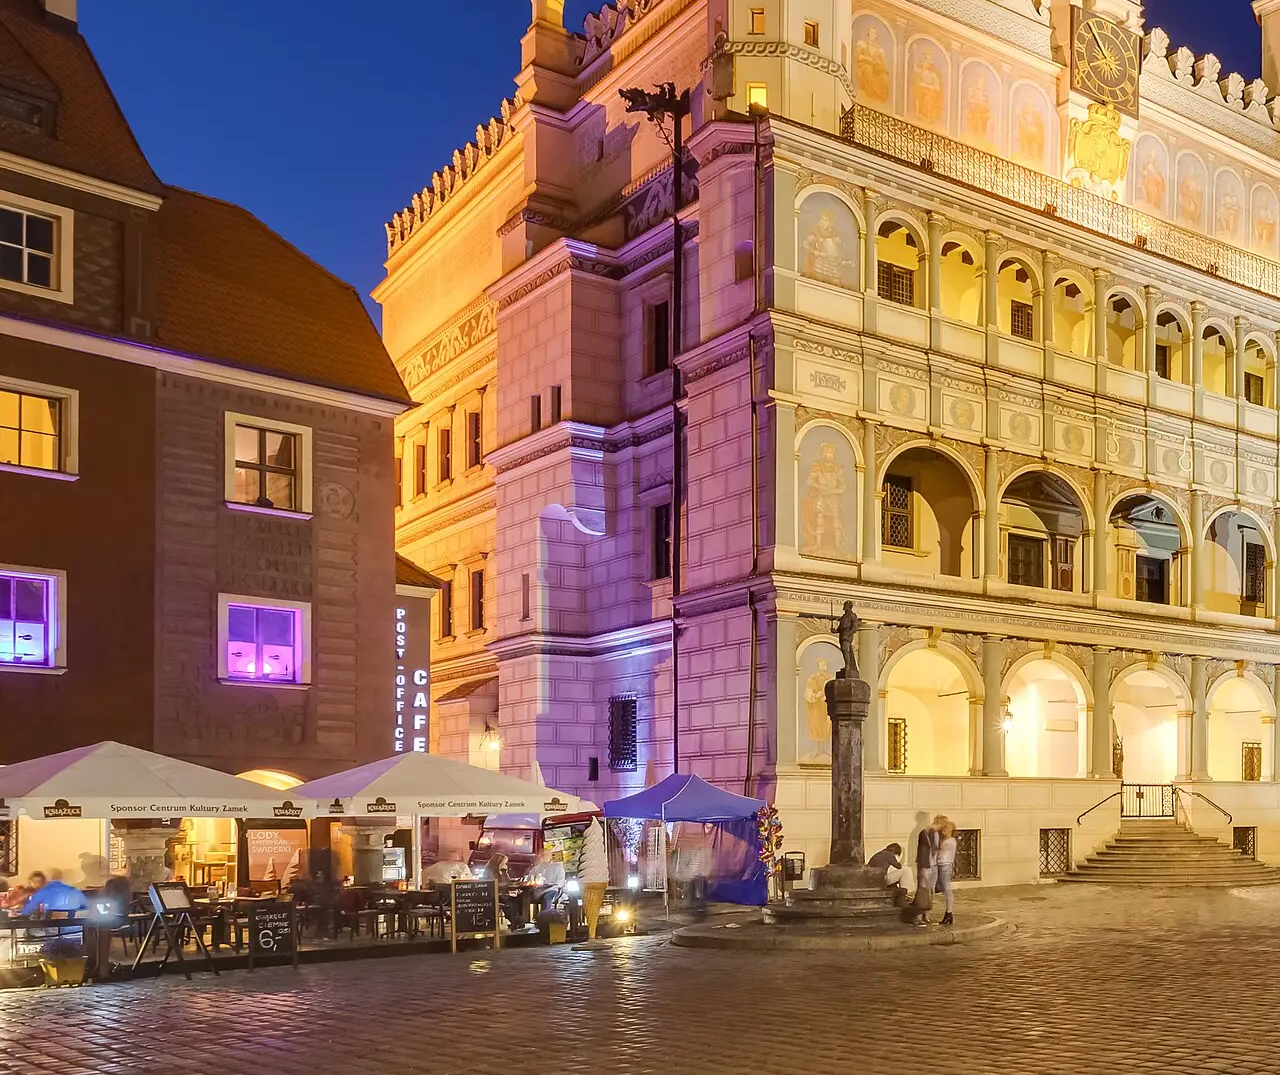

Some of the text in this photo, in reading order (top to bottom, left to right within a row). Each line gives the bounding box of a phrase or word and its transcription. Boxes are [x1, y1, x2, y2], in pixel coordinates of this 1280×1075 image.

[413, 669, 428, 752] CAFE
[110, 804, 249, 813] Sponsor Centrum Kultury Zamek
[417, 801, 446, 809] Sponsor
[251, 831, 280, 840] LODY
